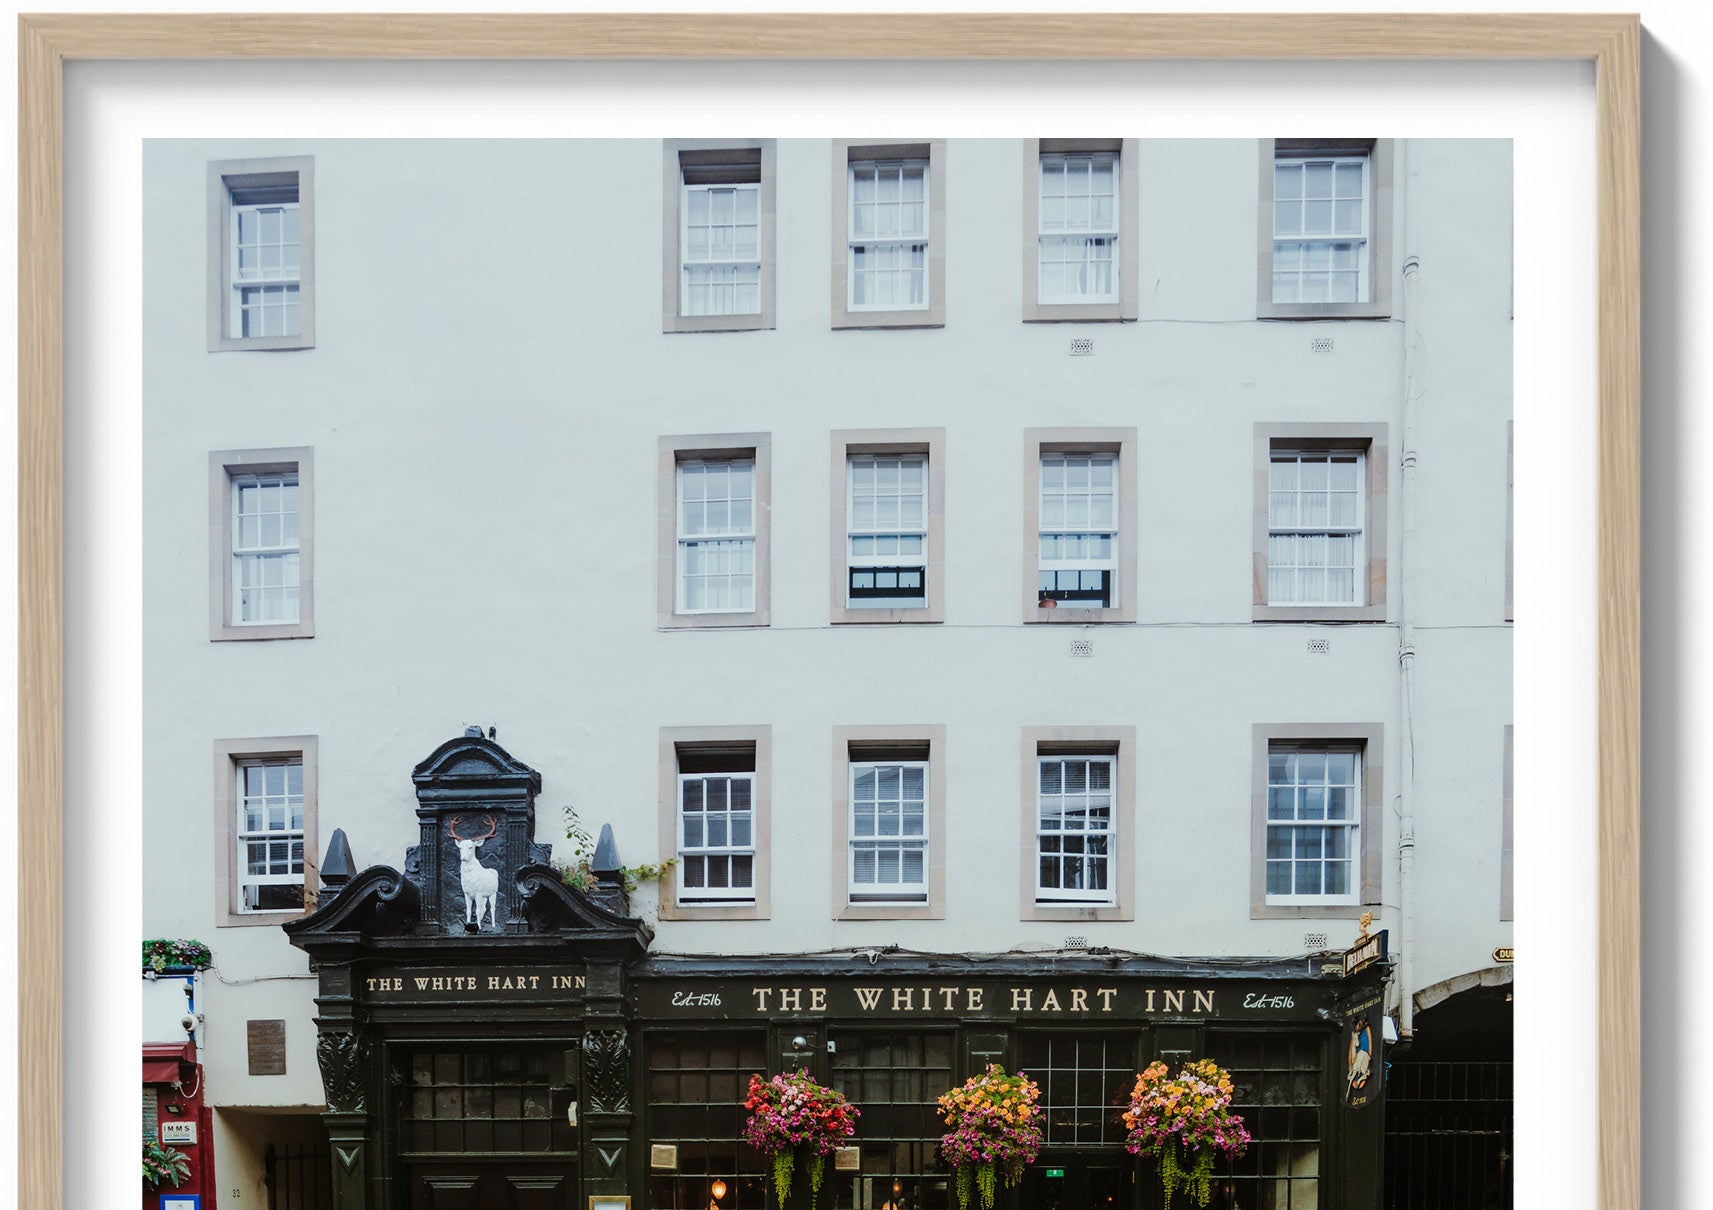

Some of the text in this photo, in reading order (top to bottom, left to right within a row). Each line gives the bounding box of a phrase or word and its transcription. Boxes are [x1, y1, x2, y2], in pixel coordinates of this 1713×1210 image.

[366, 976, 586, 991] THE WHITE HART INN
[671, 991, 722, 1007] Est. 1516
[752, 987, 1215, 1013] THE WHITE HART INN
[1243, 992, 1295, 1009] Est. 1516
